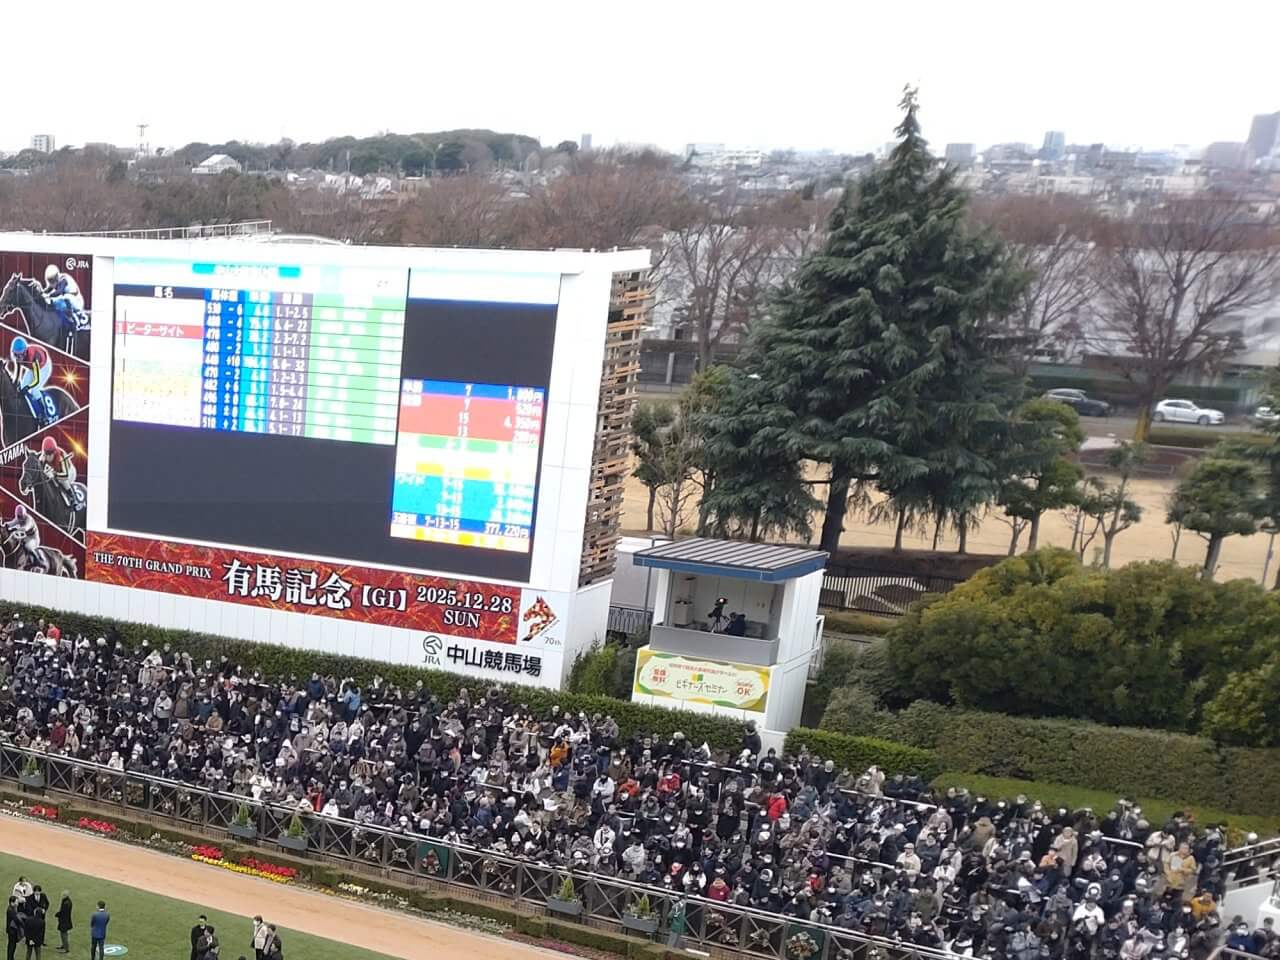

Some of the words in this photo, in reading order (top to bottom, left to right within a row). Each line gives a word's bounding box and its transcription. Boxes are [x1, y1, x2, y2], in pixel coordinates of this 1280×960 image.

[45, 396, 55, 415] 8
[424, 516, 460, 530] 7-13-15
[94, 552, 114, 565] THE
[117, 556, 143, 569] 70TH
[146, 559, 183, 575] GRAND
[186, 565, 212, 579] PRIX
[222, 559, 352, 611] 有馬記念
[361, 585, 407, 612] 【GI】
[416, 586, 512, 614] 2025.12.28
[443, 609, 480, 629] SUN
[544, 636, 561, 645] 70th
[422, 654, 441, 666] JRA
[446, 643, 542, 677] 中山競馬場
[736, 687, 751, 697] OK
